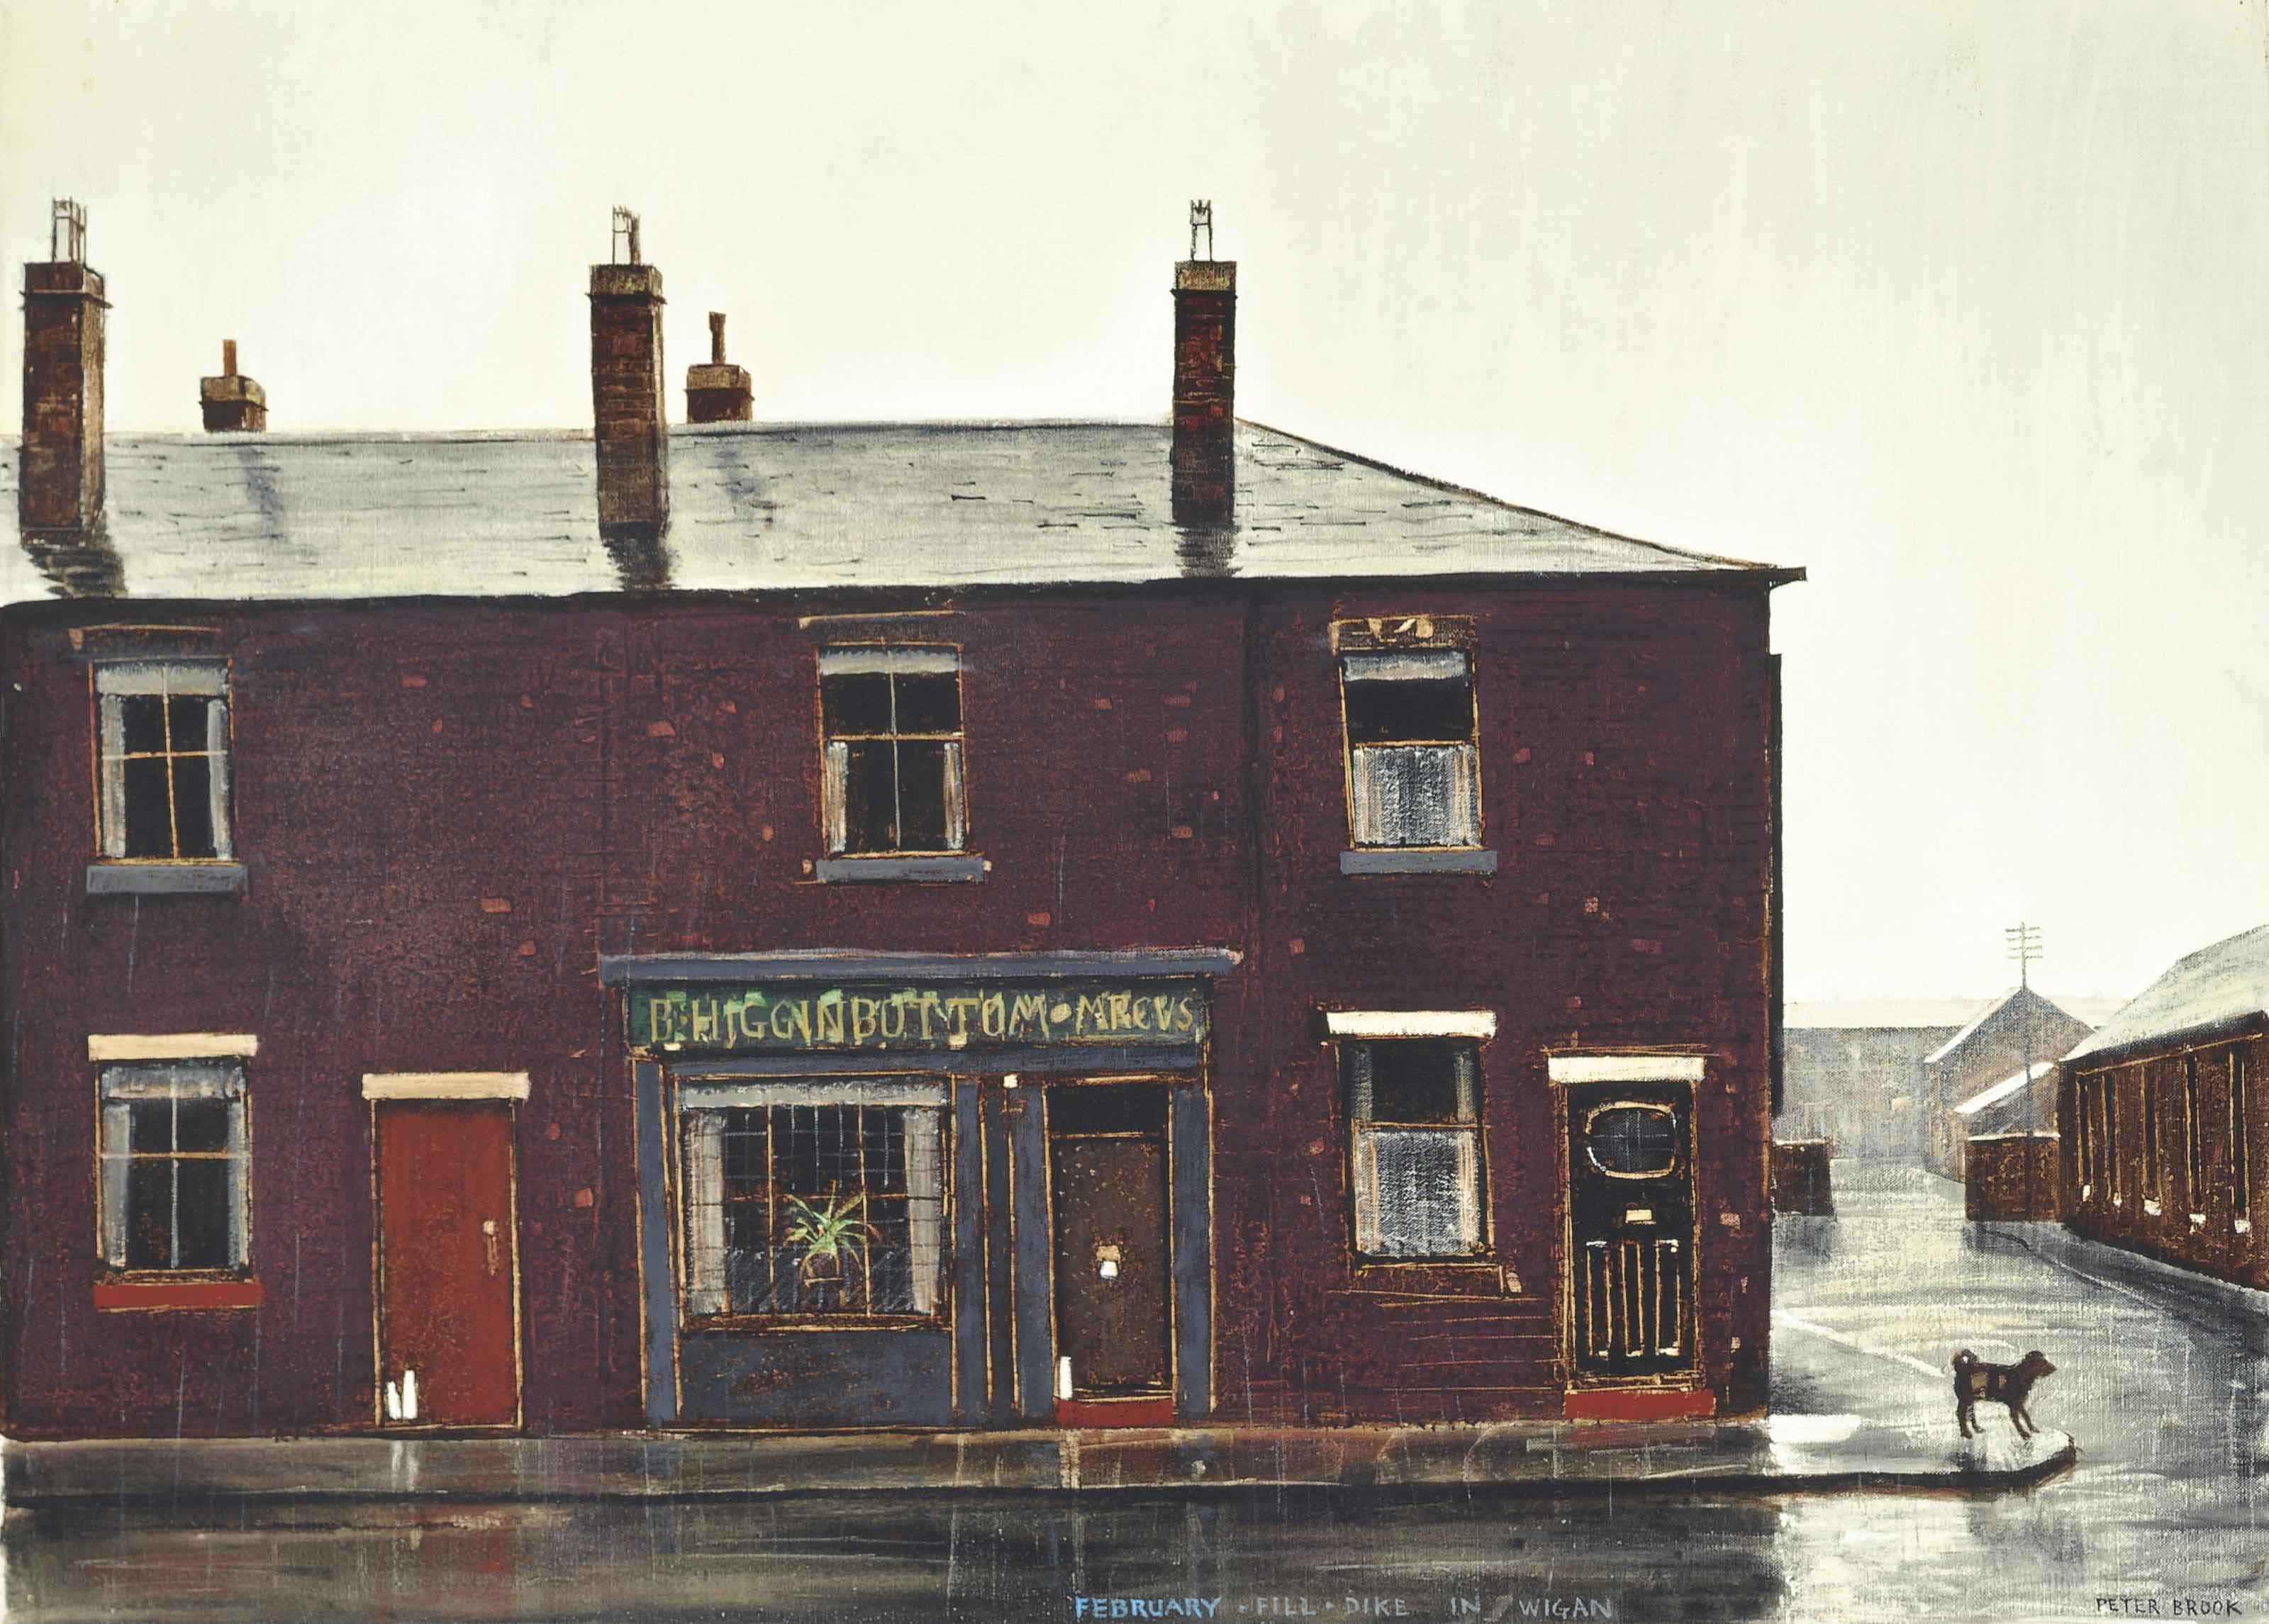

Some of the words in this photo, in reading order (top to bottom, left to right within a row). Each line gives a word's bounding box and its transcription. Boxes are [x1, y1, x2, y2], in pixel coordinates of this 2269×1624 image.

[1075, 1596, 1221, 1618] FEBRUARY
[1256, 1597, 1317, 1617] FILL
[1346, 1596, 1410, 1616] DIKE
[1451, 1596, 1481, 1614] IN
[1519, 1597, 1612, 1619] WIGAN
[2096, 1598, 2160, 1615] PETER
[2173, 1598, 2242, 1617] BROOK
